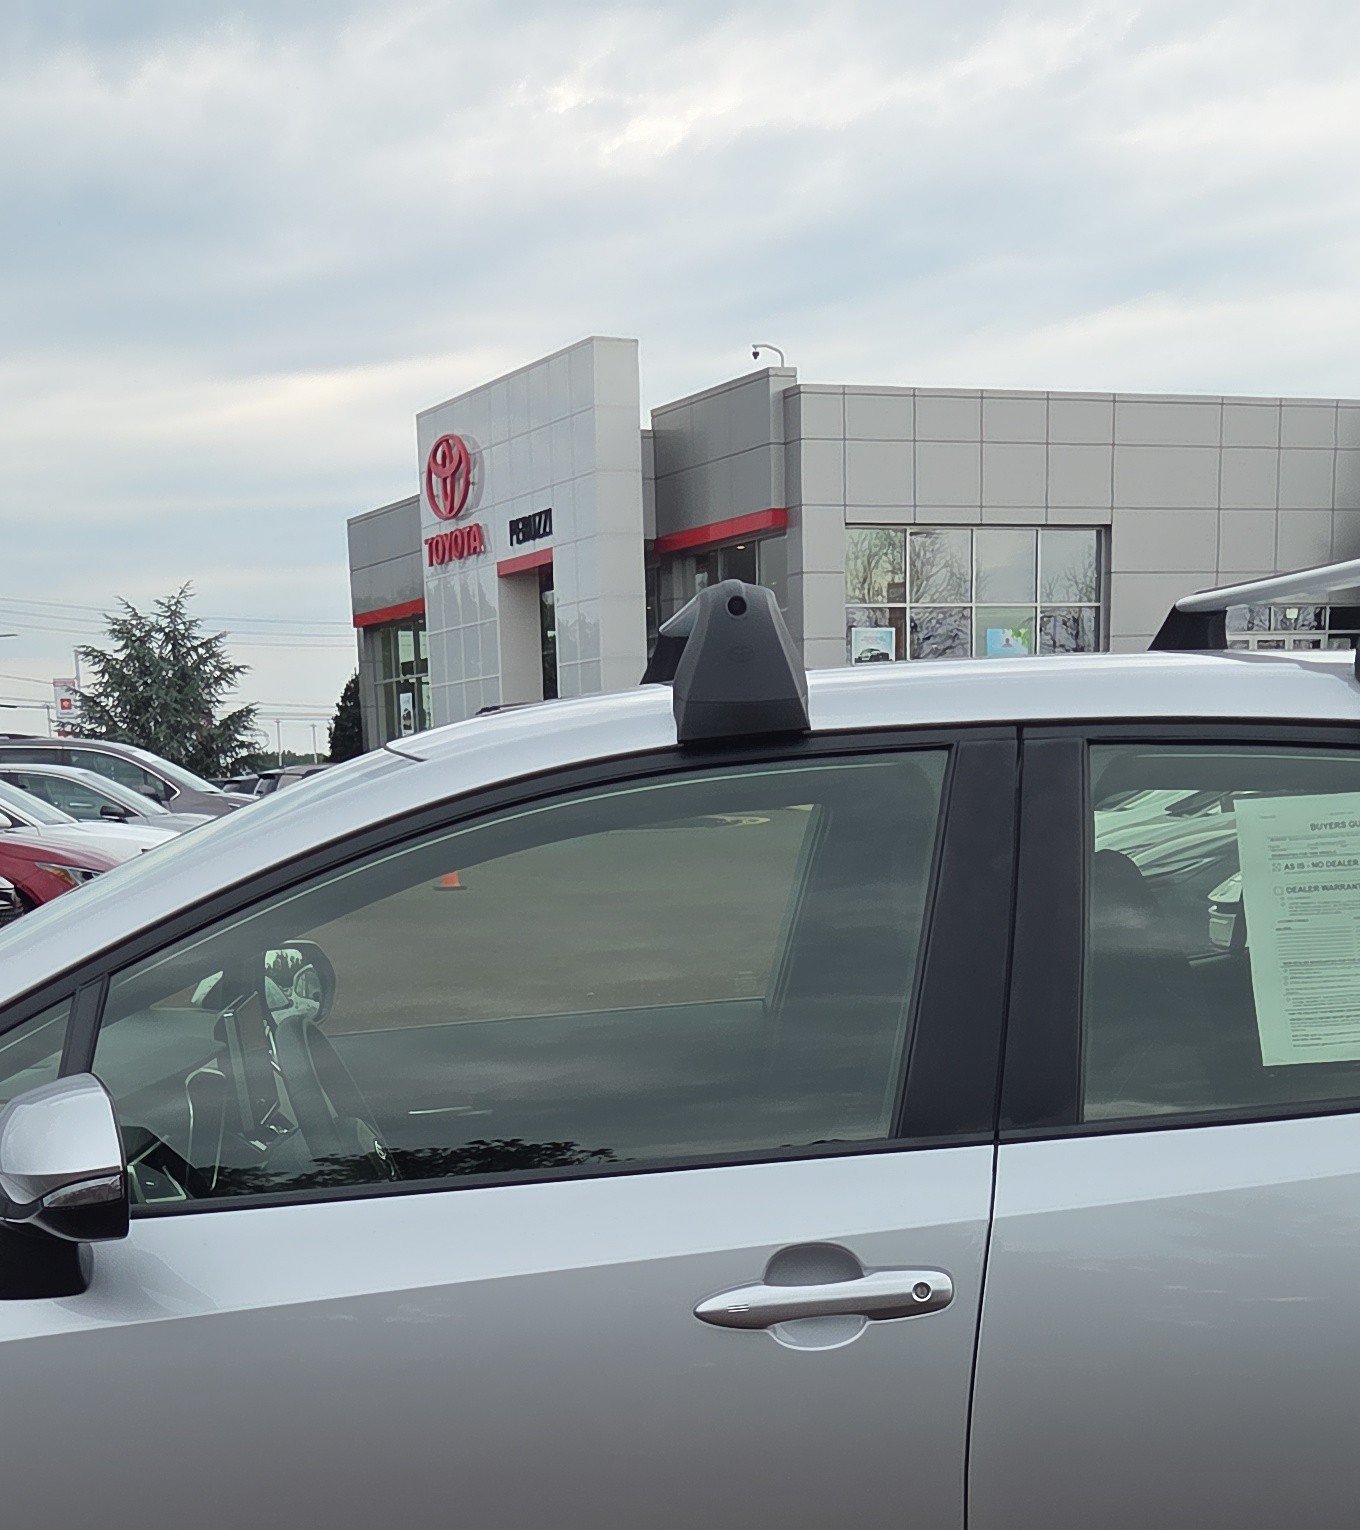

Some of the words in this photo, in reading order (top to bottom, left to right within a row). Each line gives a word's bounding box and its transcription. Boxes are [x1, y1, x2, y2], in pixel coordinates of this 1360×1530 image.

[424, 522, 485, 567] TOYOTA
[1309, 820, 1347, 831] BUYERS
[1284, 862, 1295, 871] AS
[1296, 862, 1306, 870] IS
[1311, 861, 1325, 869] NO
[1325, 858, 1359, 868] DEALER
[1285, 885, 1320, 895] DEALER
